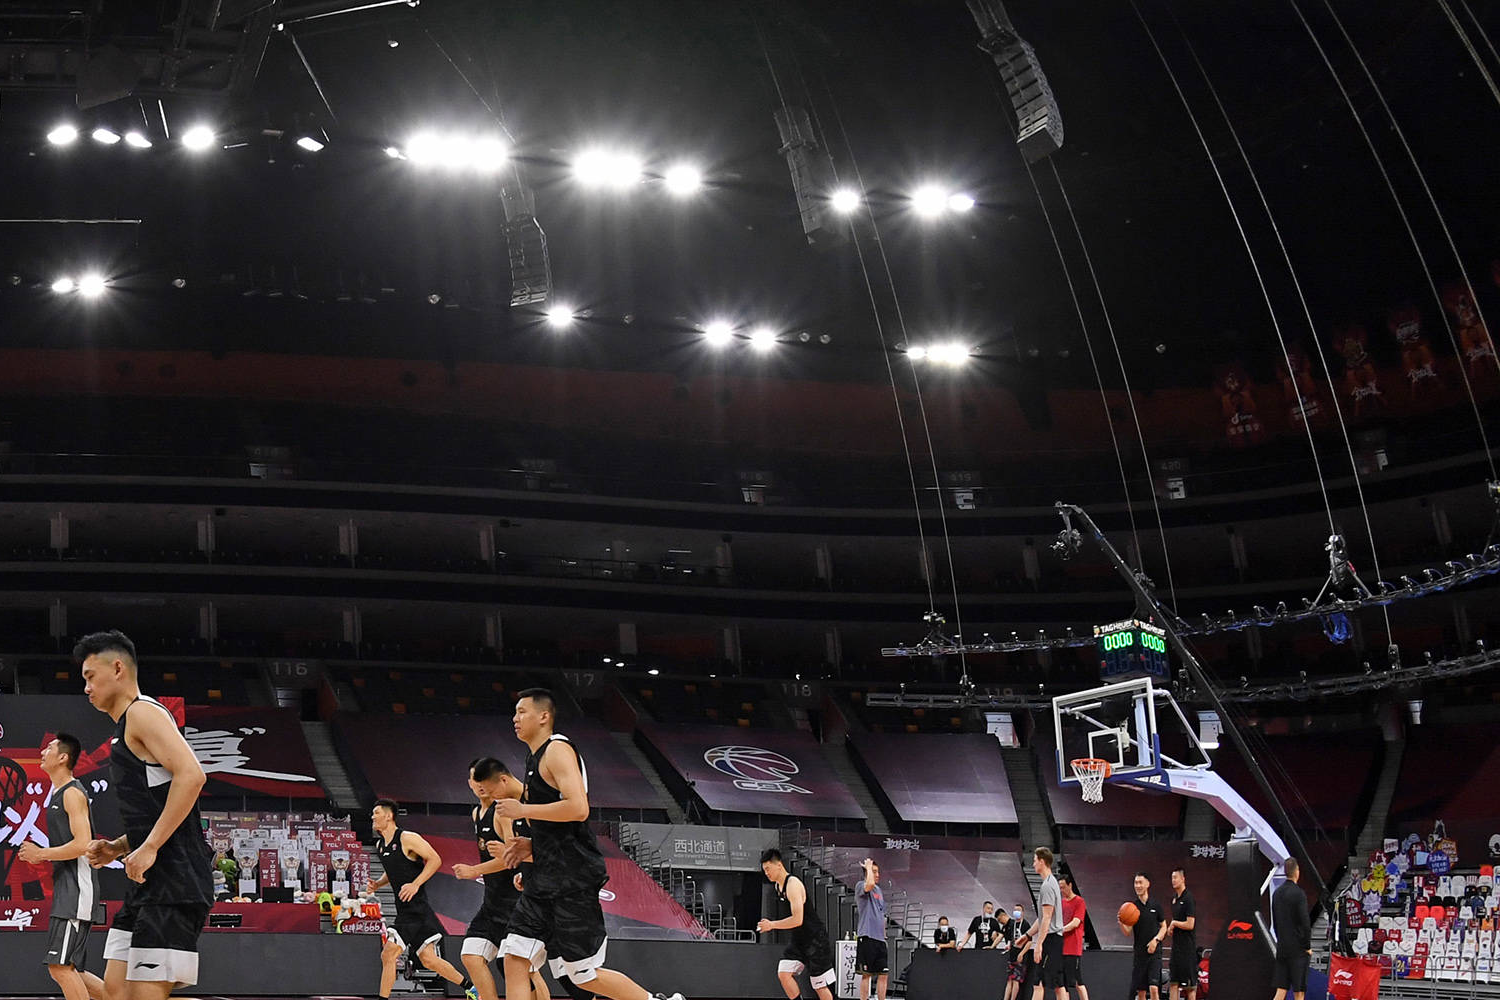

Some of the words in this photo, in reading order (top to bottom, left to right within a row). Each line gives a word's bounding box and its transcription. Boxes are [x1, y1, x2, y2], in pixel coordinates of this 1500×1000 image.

[274, 662, 307, 676] 116
[781, 683, 812, 697] 118
[733, 780, 814, 794] CBA
[674, 839, 725, 855] 西北通道
